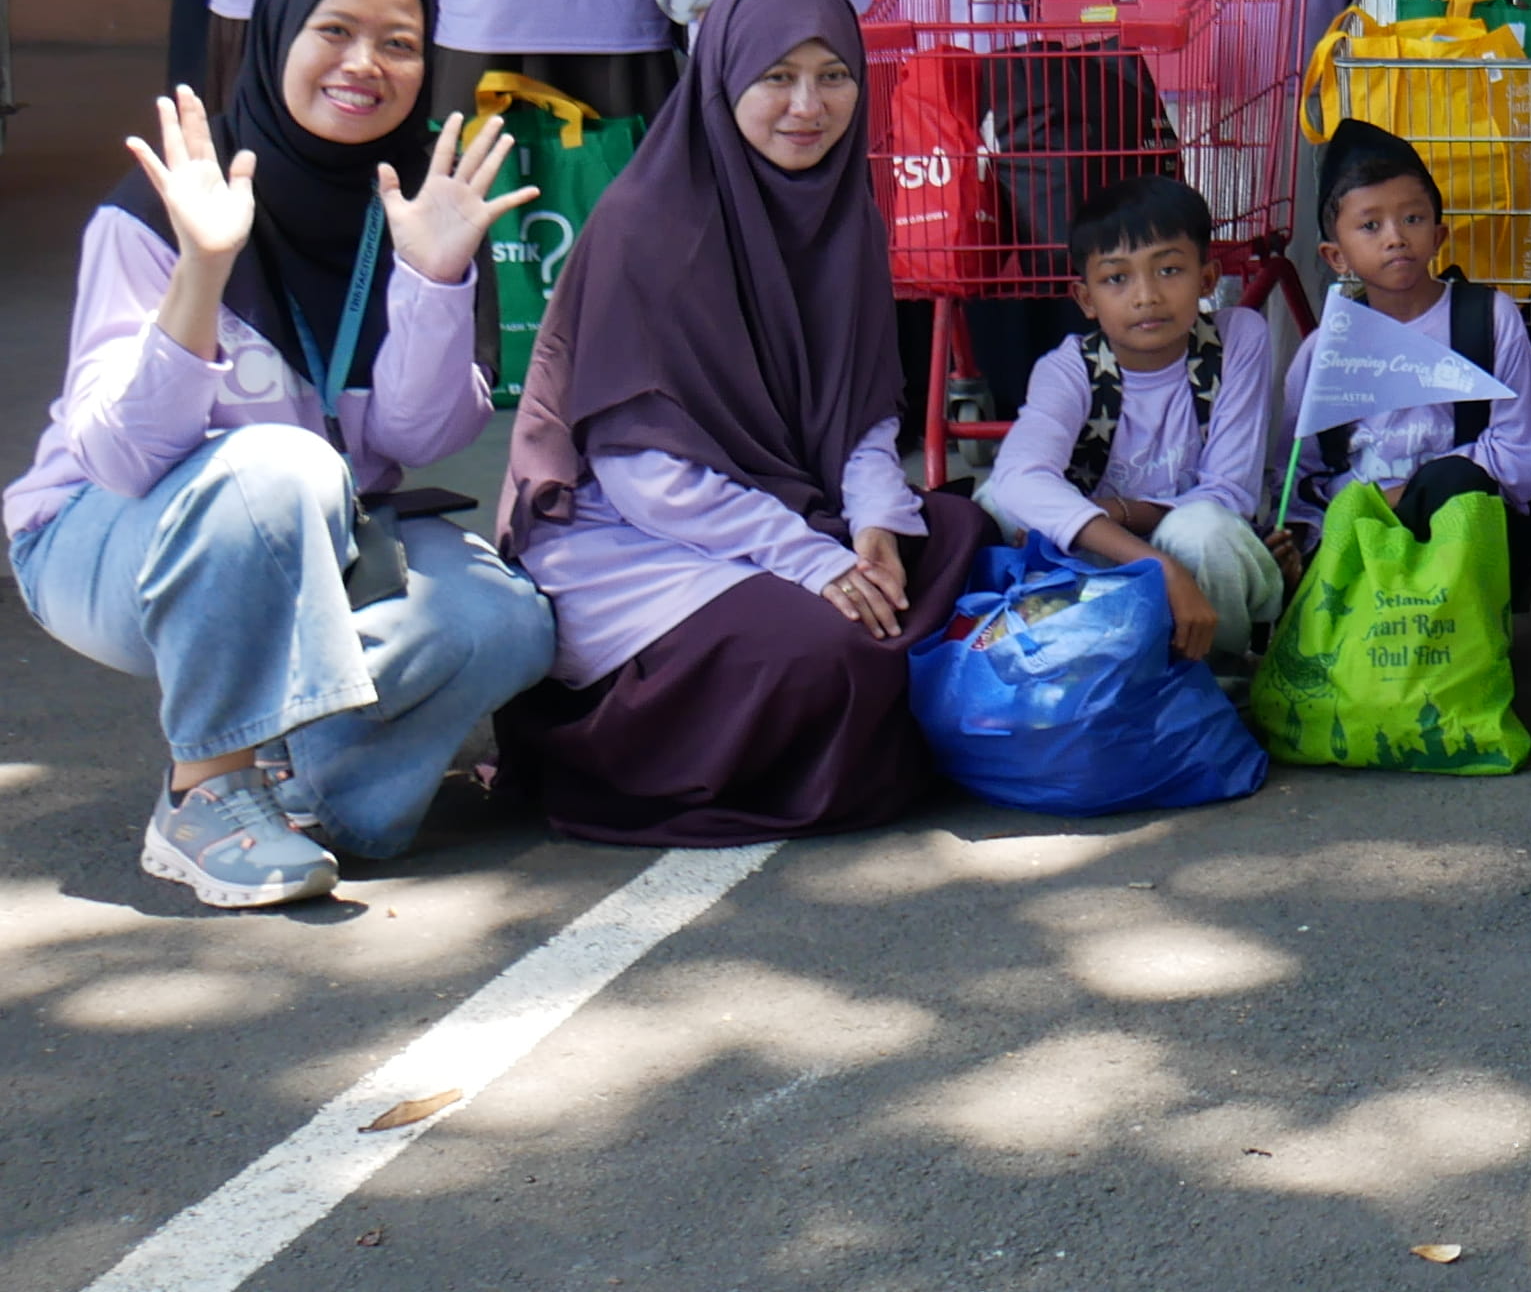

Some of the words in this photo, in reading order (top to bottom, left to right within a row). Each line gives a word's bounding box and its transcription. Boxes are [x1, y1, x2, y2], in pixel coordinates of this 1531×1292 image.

[1318, 349, 1387, 378] Shopping
[1390, 354, 1432, 374] Ceria
[1341, 389, 1376, 404] ASTRA
[1374, 588, 1449, 609] Selamat
[1411, 613, 1457, 640] Raya
[1367, 647, 1409, 668] Idul
[1413, 646, 1452, 667] Fitri
